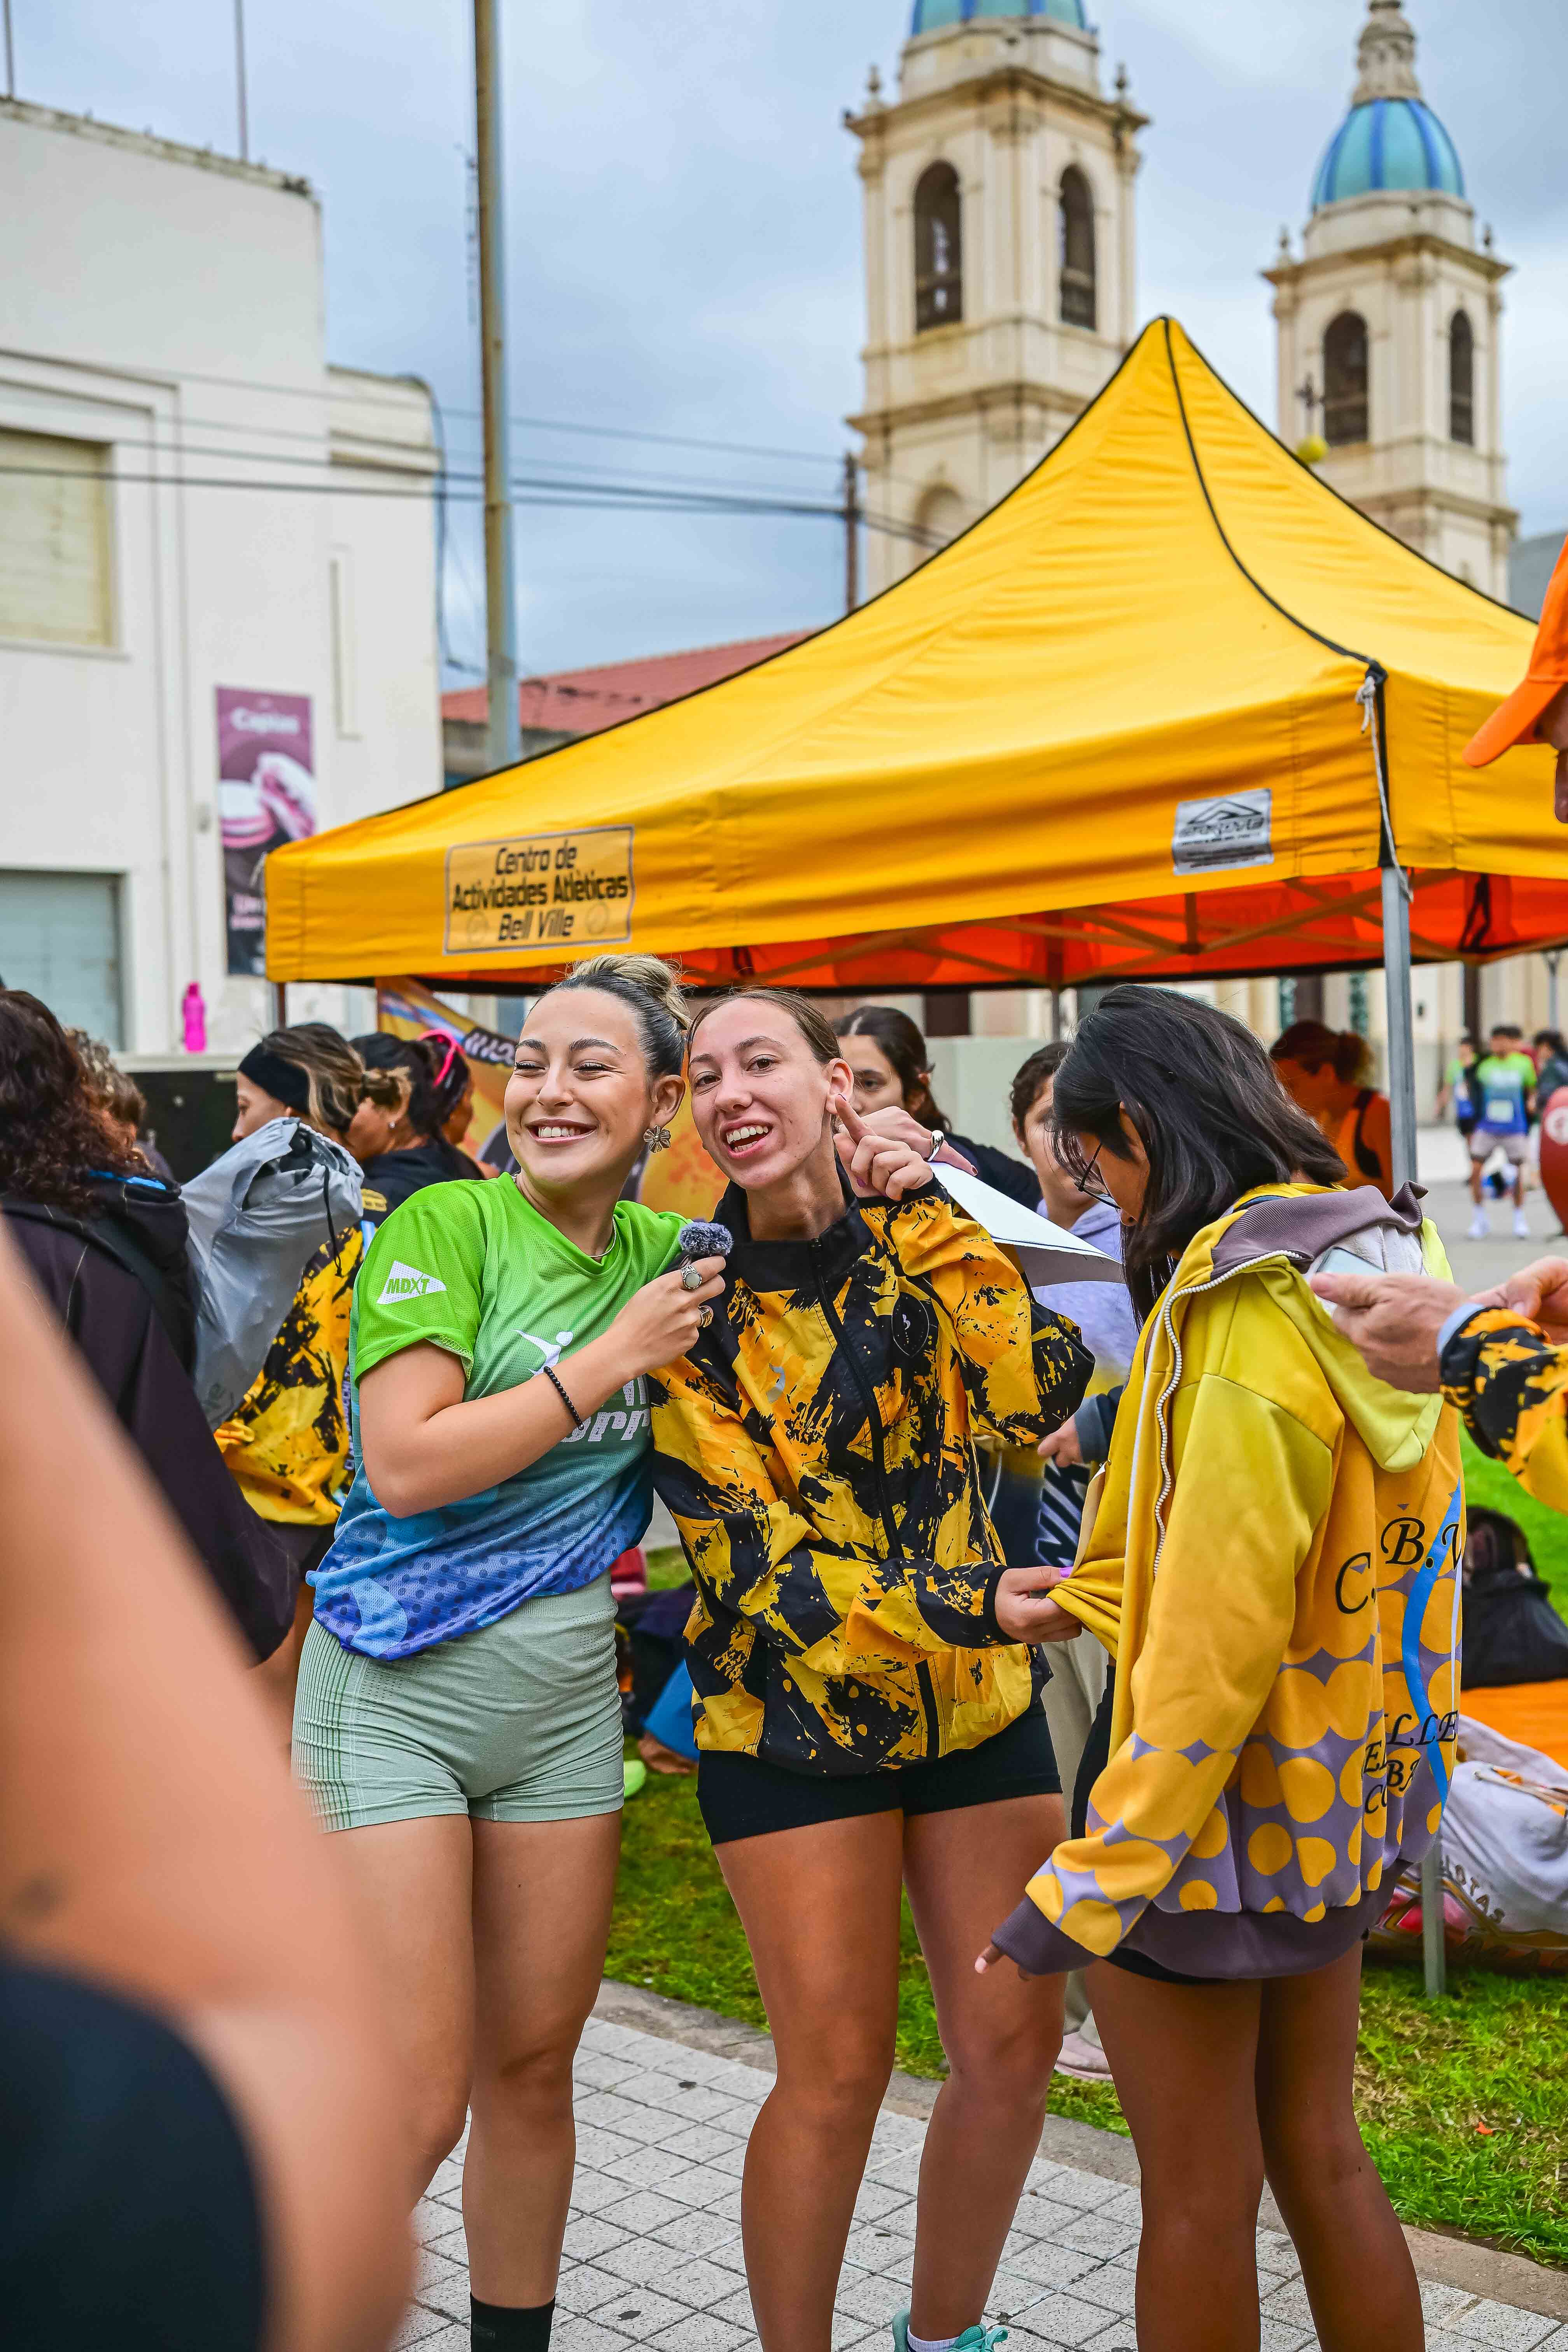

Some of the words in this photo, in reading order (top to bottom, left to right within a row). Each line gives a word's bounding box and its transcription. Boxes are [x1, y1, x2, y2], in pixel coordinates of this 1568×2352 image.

[495, 845, 550, 875] Centro
[555, 838, 577, 870] de
[452, 877, 548, 910] Actividades
[498, 910, 534, 941] Bell
[539, 908, 575, 937] Ville
[385, 1273, 430, 1295] MDXT
